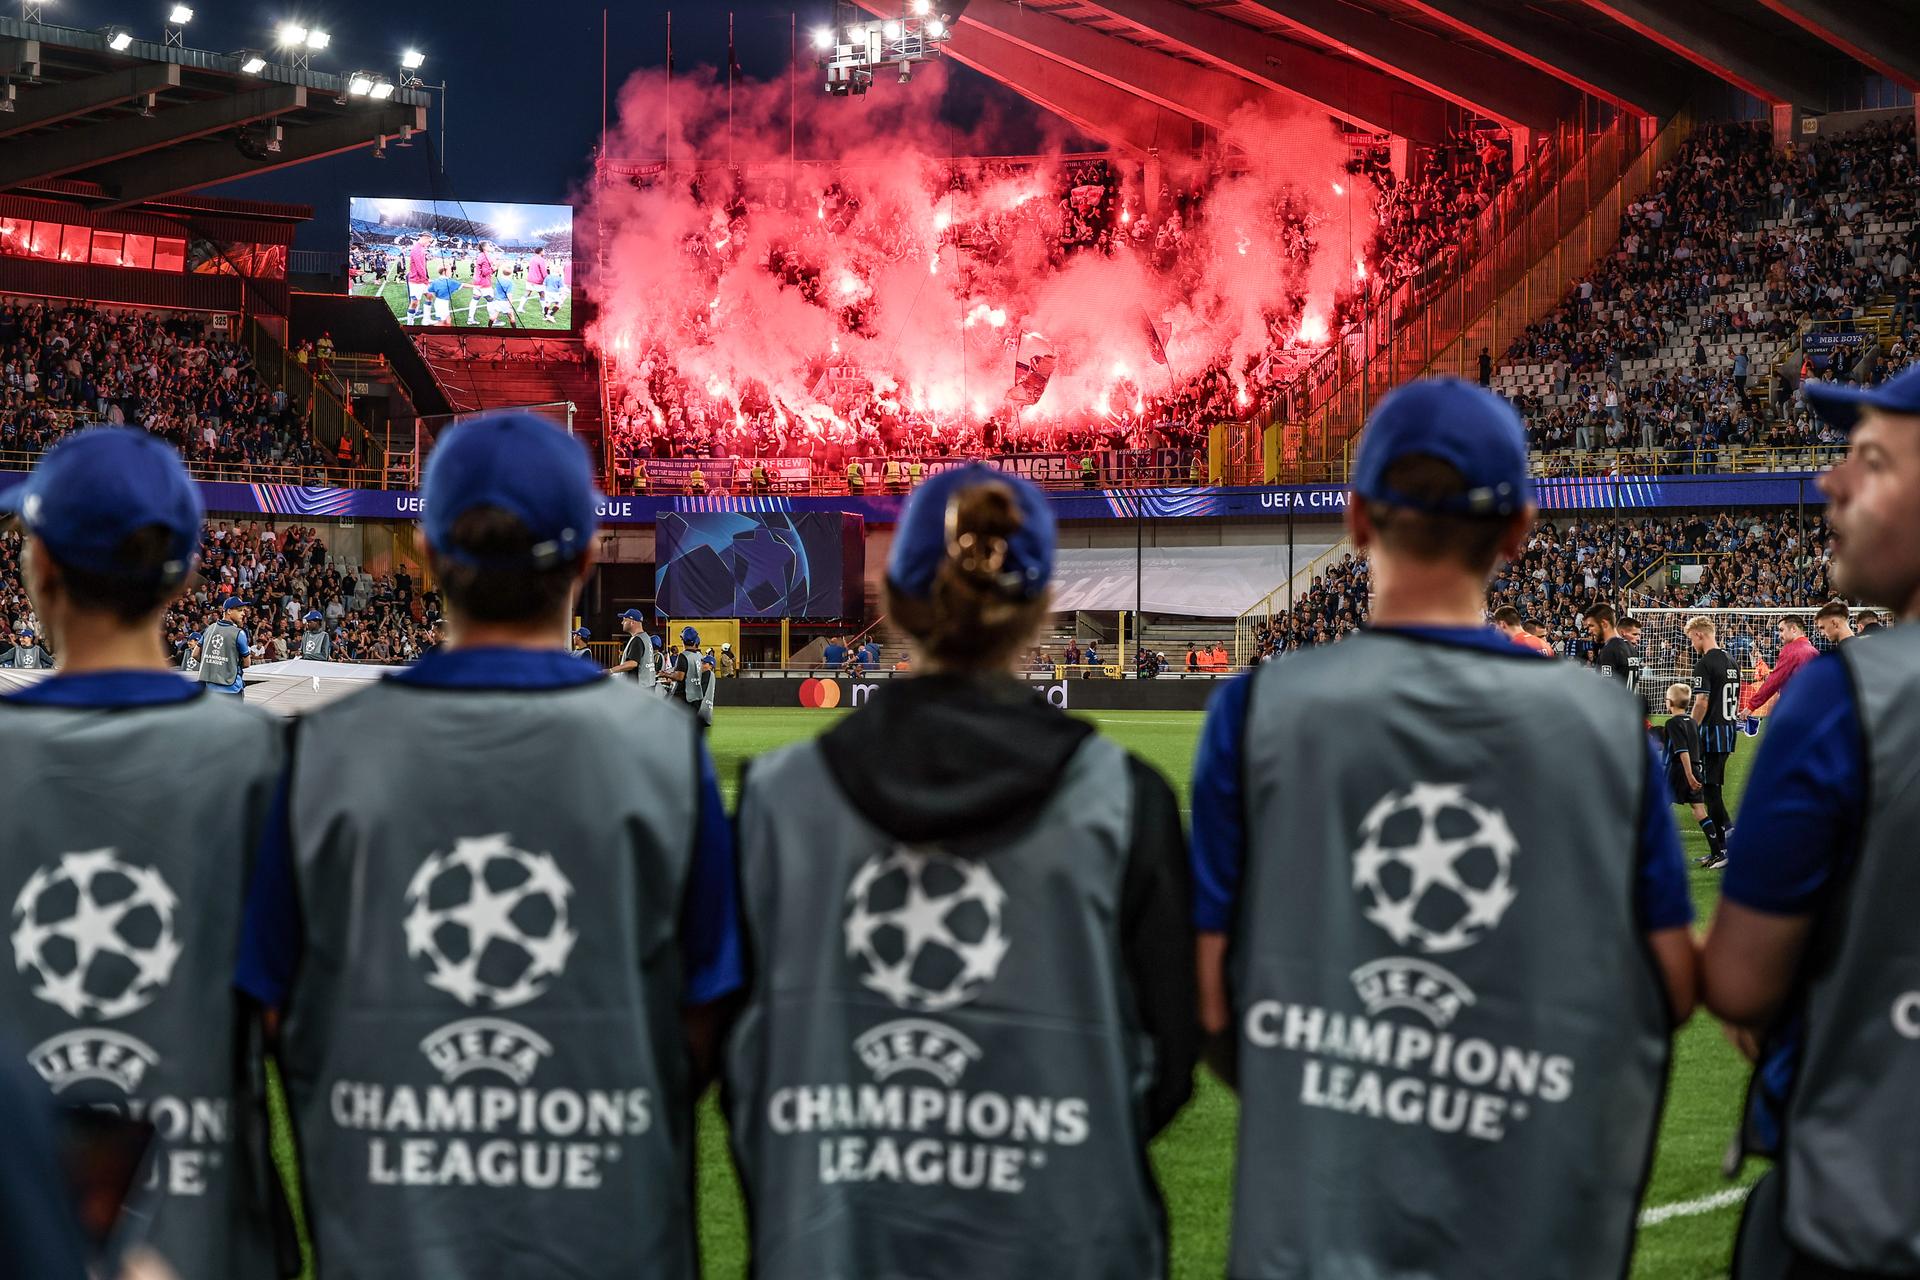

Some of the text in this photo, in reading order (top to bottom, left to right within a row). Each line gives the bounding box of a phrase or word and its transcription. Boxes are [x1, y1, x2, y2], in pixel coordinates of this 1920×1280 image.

[214, 316, 227, 326] 325
[1819, 335, 1862, 344] MBK BOYS
[1261, 492, 1305, 507] UEFA
[1356, 968, 1462, 1027] UEFA
[34, 1040, 149, 1093] UEFA
[424, 1027, 541, 1081] UEFA
[857, 1032, 971, 1084] UEFA
[1245, 999, 1575, 1103] CHAMPIONS
[330, 1080, 652, 1136] CHAMPIONS
[768, 1083, 1090, 1146] CHAMPIONS
[1300, 1059, 1508, 1143] LEAGUE
[368, 1137, 602, 1190] LEAGUE
[818, 1136, 1026, 1195] LEAGUE
